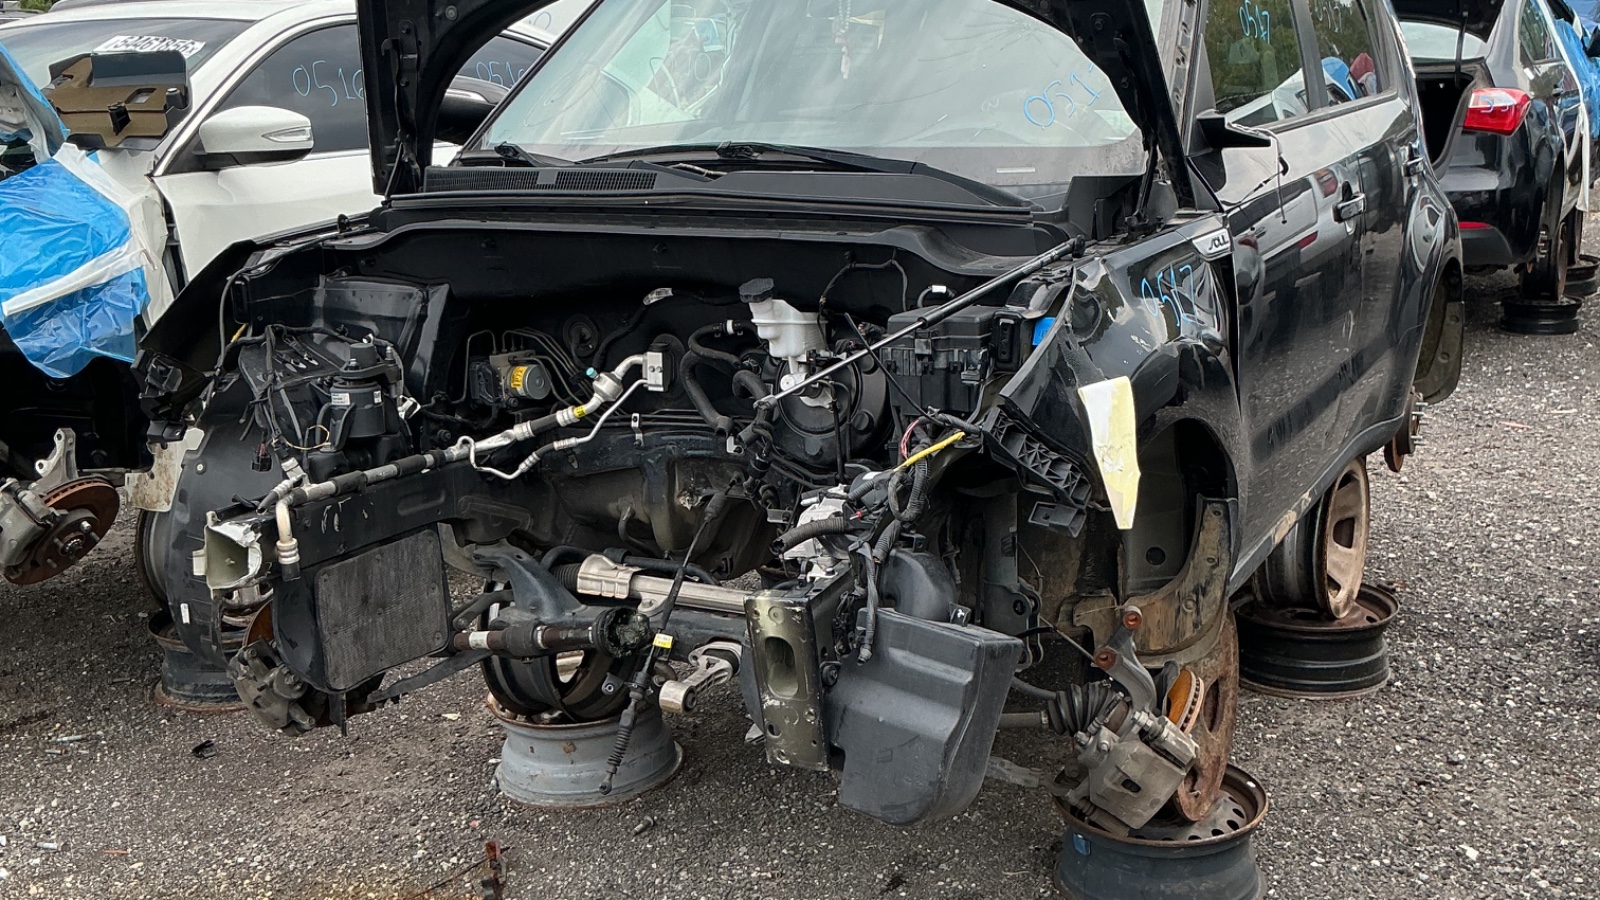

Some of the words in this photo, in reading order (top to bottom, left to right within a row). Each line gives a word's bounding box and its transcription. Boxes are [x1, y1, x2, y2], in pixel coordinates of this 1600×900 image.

[292, 60, 364, 107] 0516
[1024, 63, 1101, 127] 051
[1141, 263, 1198, 327] 0517
